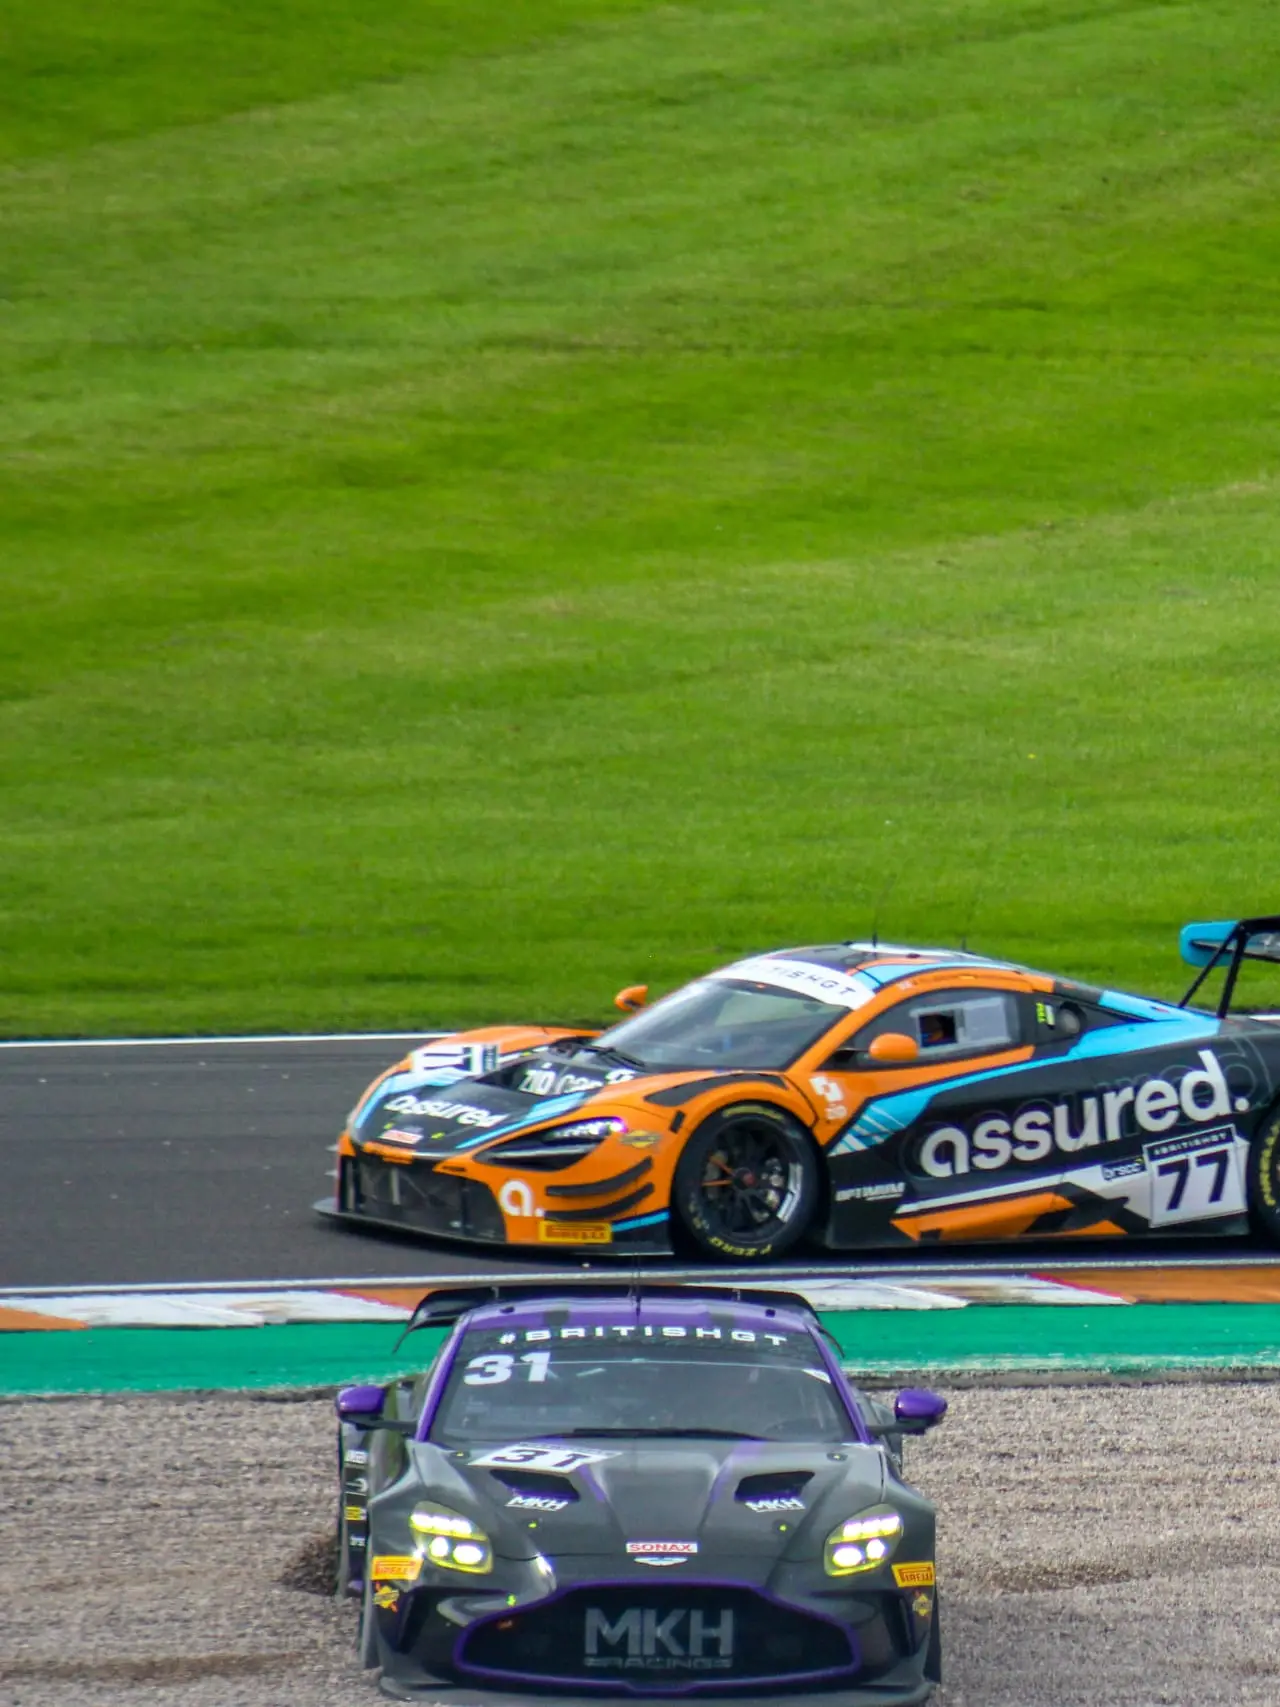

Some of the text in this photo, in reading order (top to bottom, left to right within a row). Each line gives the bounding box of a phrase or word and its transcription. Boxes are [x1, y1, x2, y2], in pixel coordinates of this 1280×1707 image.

[921, 1049, 1250, 1178] assured.
[1158, 1149, 1229, 1211] 77
[499, 1325, 787, 1347] #BRITISHGT
[463, 1350, 551, 1386] 31
[492, 1448, 591, 1468] 31
[508, 1496, 569, 1512] MKH
[630, 1543, 693, 1552] SONAX
[584, 1607, 734, 1657] MKH
